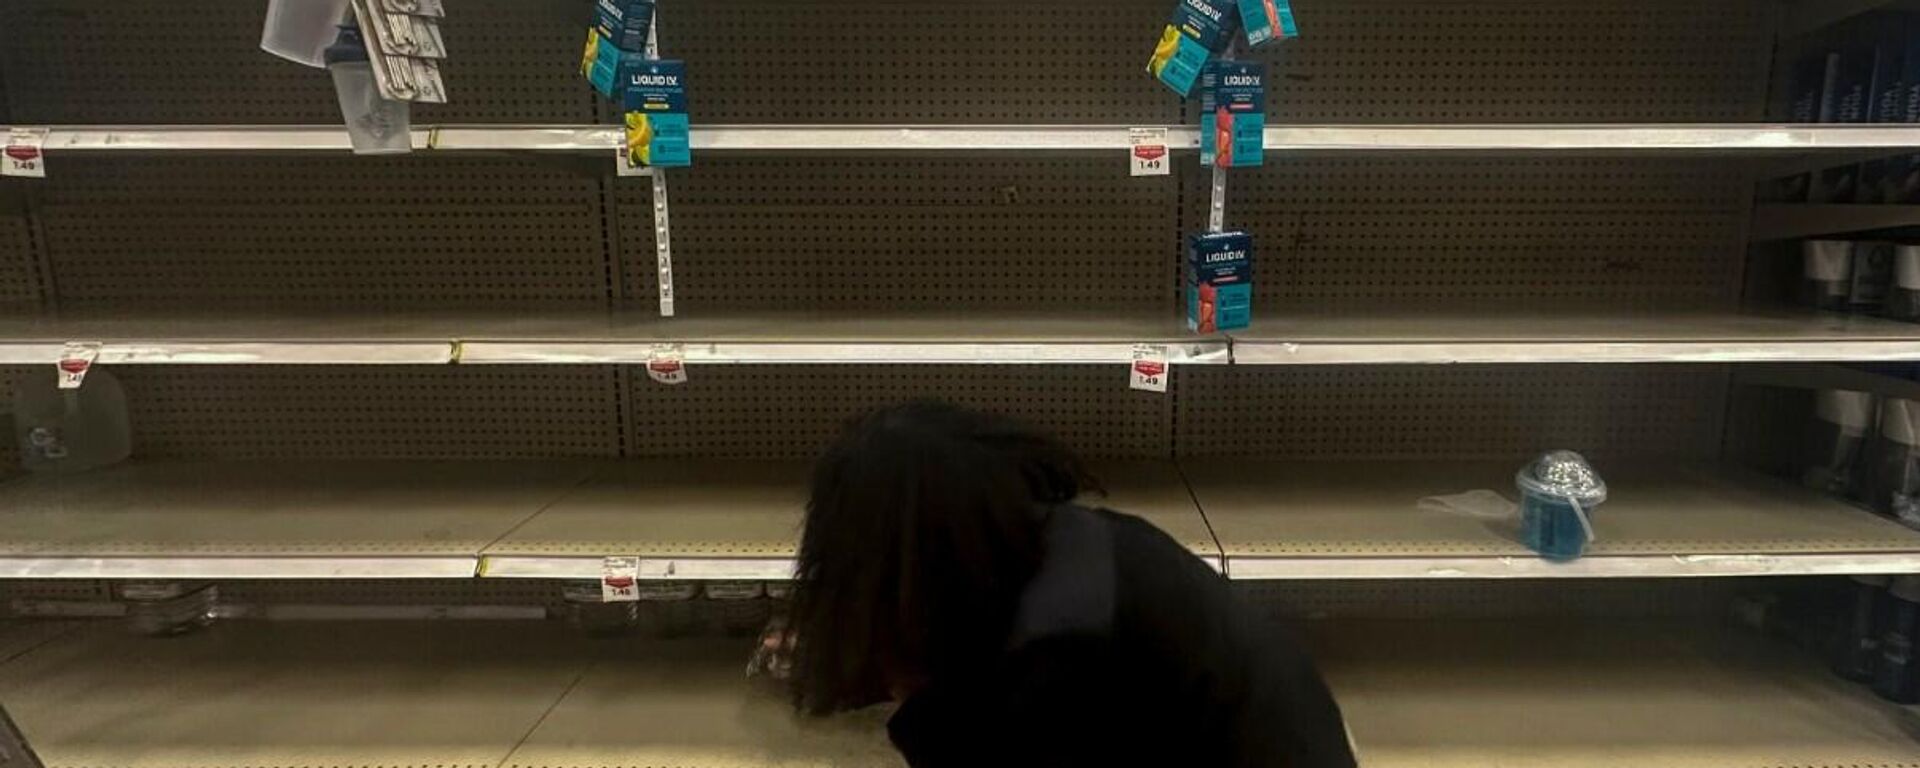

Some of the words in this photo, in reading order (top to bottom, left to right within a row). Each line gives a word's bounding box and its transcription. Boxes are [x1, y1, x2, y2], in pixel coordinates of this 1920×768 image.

[631, 74, 665, 86] LIQUID
[1223, 75, 1251, 86] LIQUID
[1206, 250, 1235, 263] LIQUID
[1138, 375, 1159, 385] 1.49
